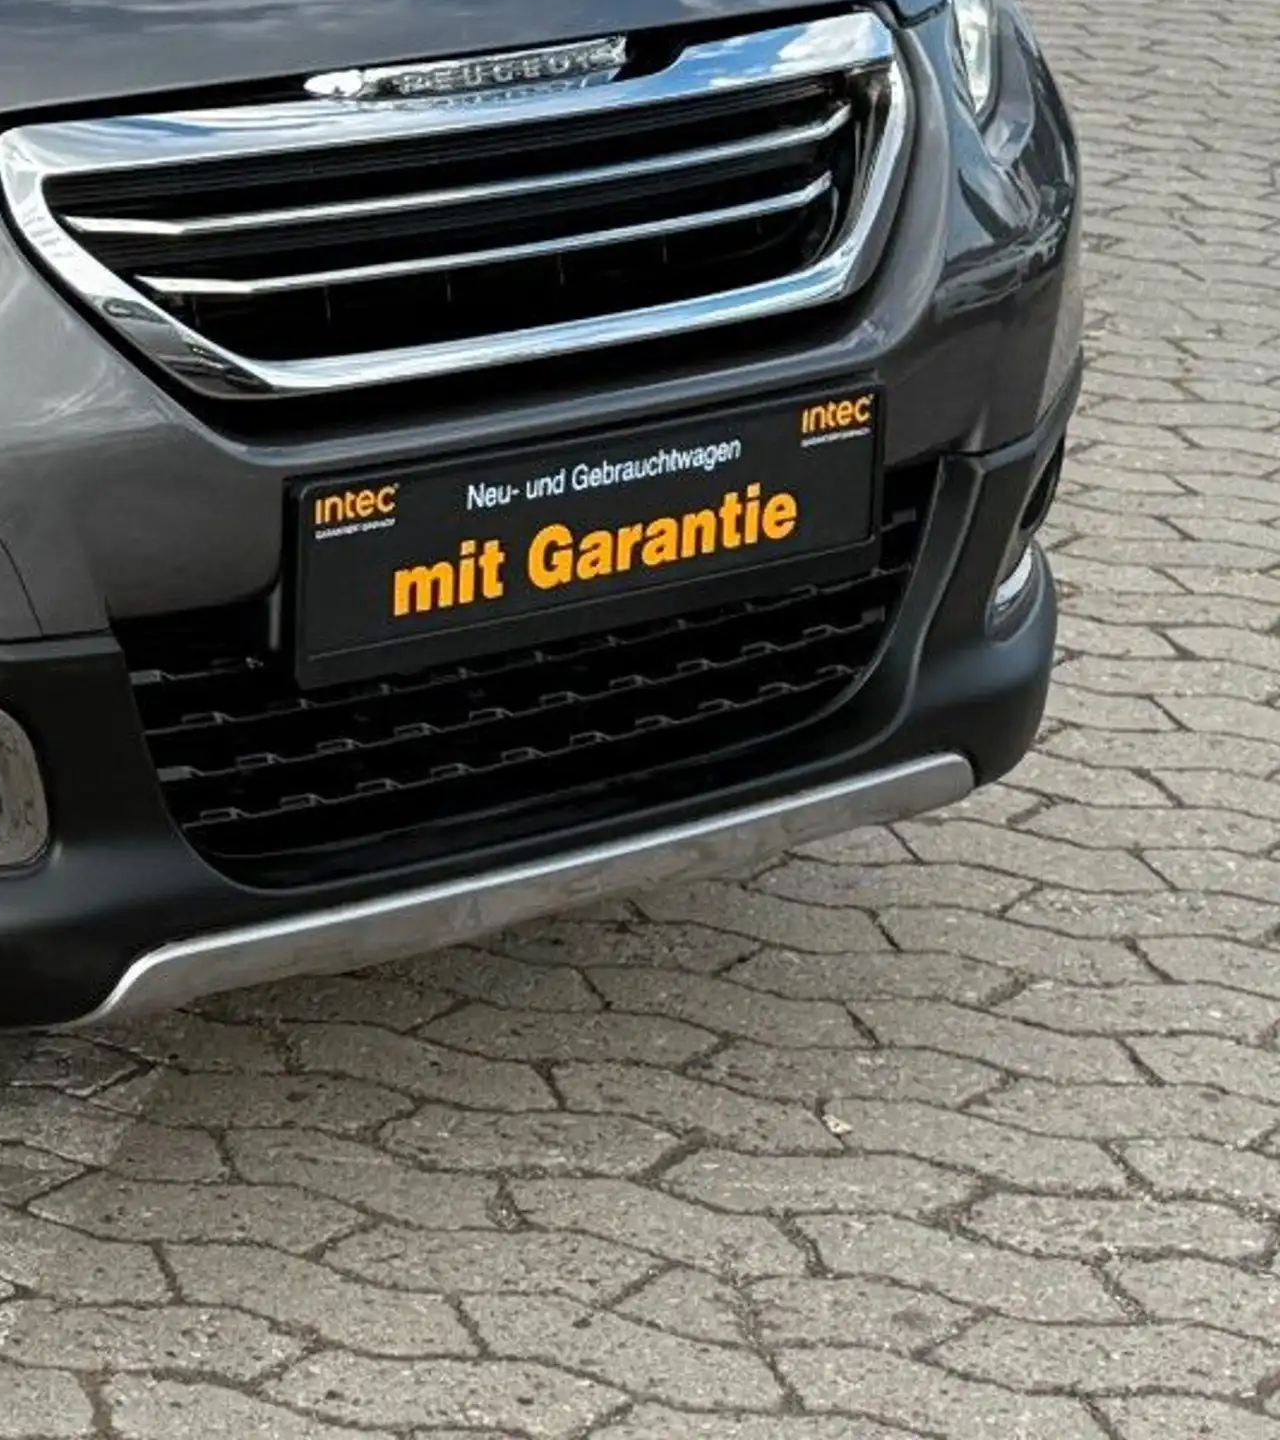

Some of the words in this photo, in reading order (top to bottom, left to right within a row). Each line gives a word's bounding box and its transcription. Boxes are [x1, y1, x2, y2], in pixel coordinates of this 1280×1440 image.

[466, 482, 520, 511] Neu-
[526, 468, 566, 500] und
[571, 438, 742, 490] Gebrauchtwagen
[393, 539, 507, 617] mit
[527, 481, 798, 590] Garantie
